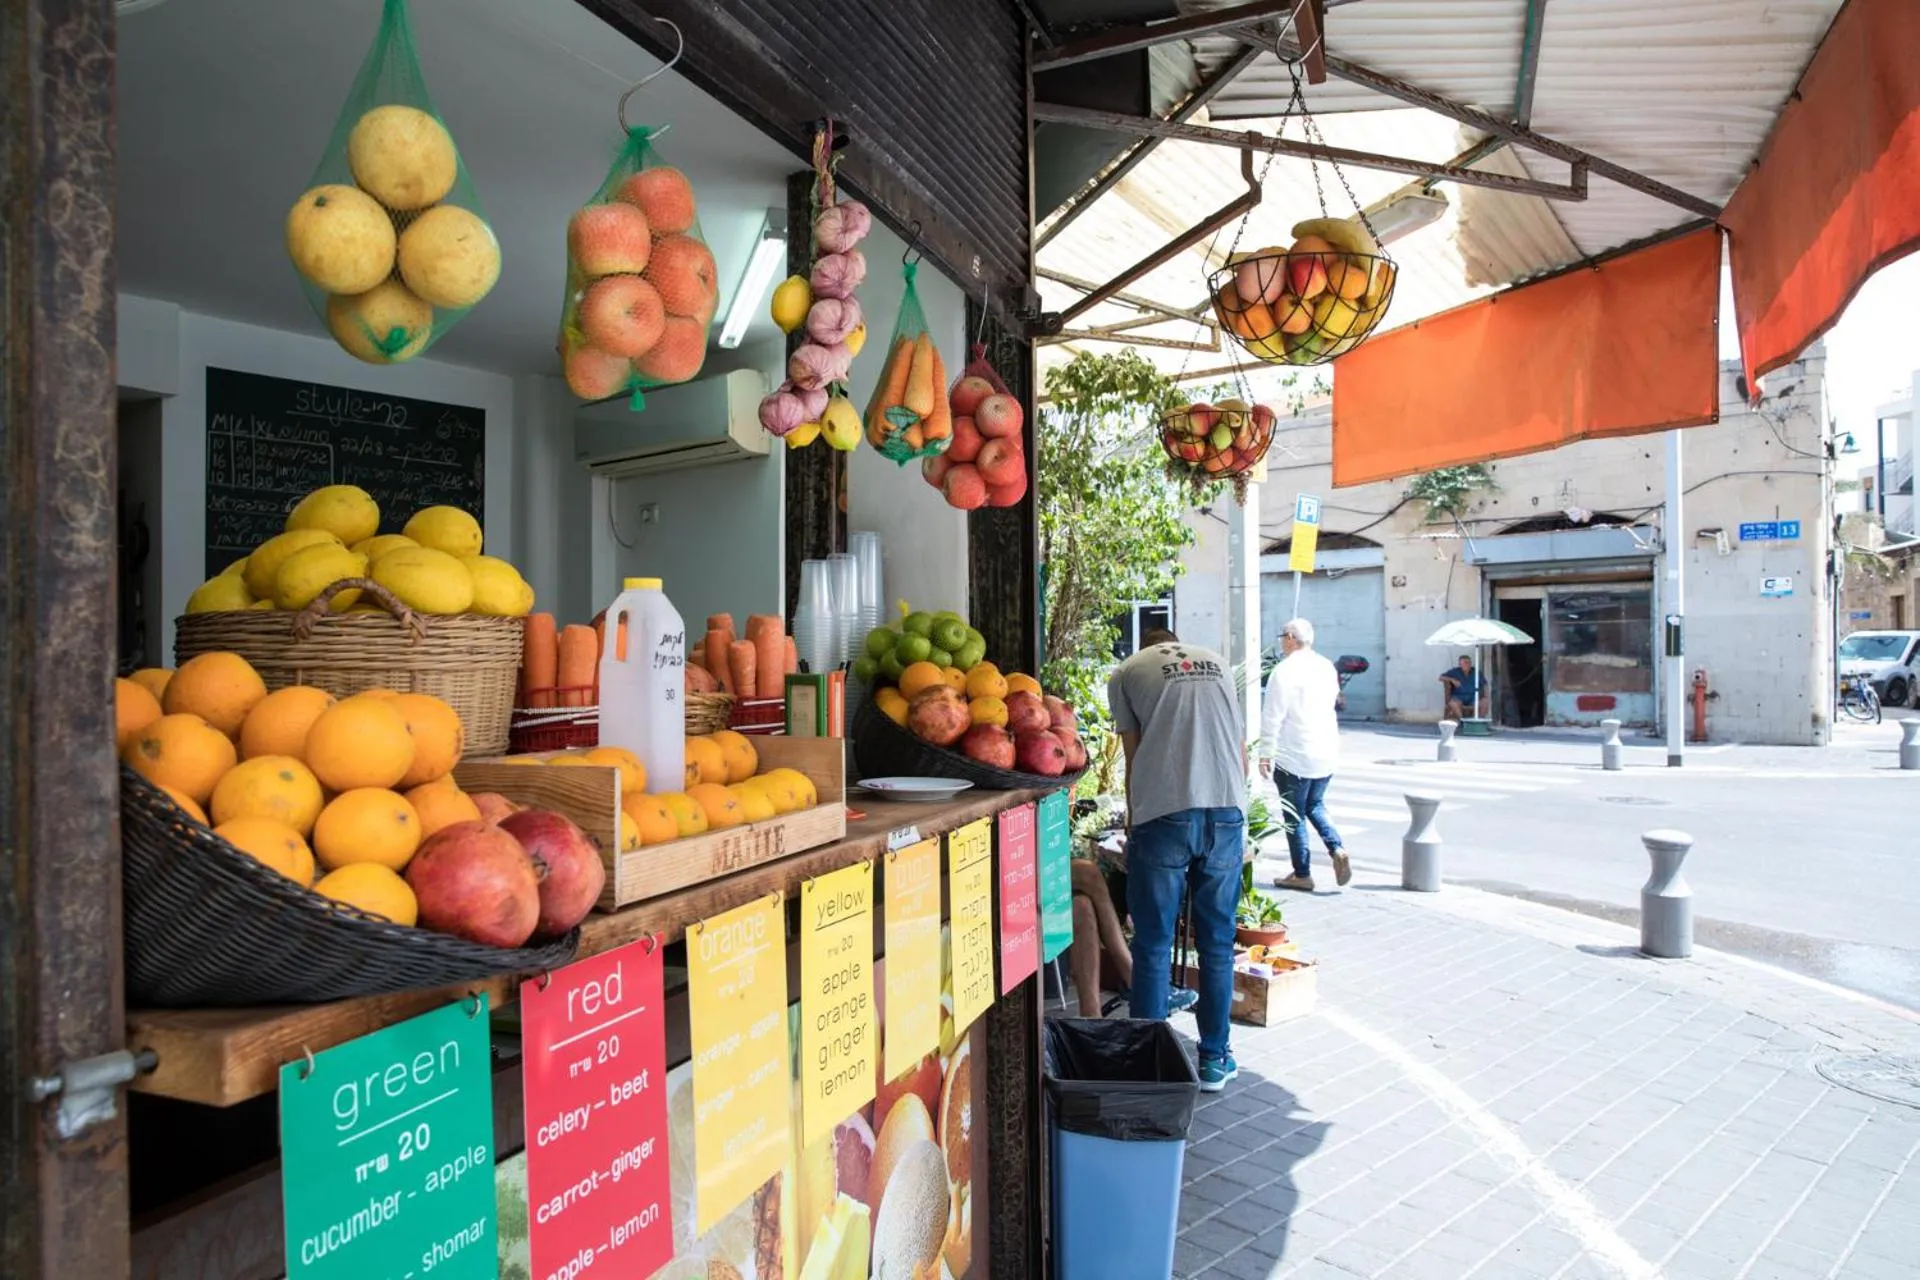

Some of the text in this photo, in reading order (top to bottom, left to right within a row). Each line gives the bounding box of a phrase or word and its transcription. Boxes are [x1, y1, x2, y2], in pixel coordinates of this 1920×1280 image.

[211, 413, 228, 430] M
[255, 420, 275, 438] XL
[1782, 524, 1797, 537] 13
[817, 887, 865, 928] yellow
[700, 911, 766, 961] orange
[841, 934, 854, 953] 20
[567, 960, 623, 1022] red
[823, 959, 862, 995] apple
[816, 992, 867, 1032] orange
[597, 1034, 621, 1064] 20
[819, 1022, 868, 1071] ginger
[332, 1039, 460, 1131] green
[820, 1058, 866, 1099] lemon
[536, 1103, 592, 1148] celery
[610, 1068, 649, 1107] beet
[397, 1122, 431, 1162] 20
[300, 1190, 402, 1266] cucumber
[424, 1143, 487, 1193] apple
[421, 1215, 487, 1273] shomar
